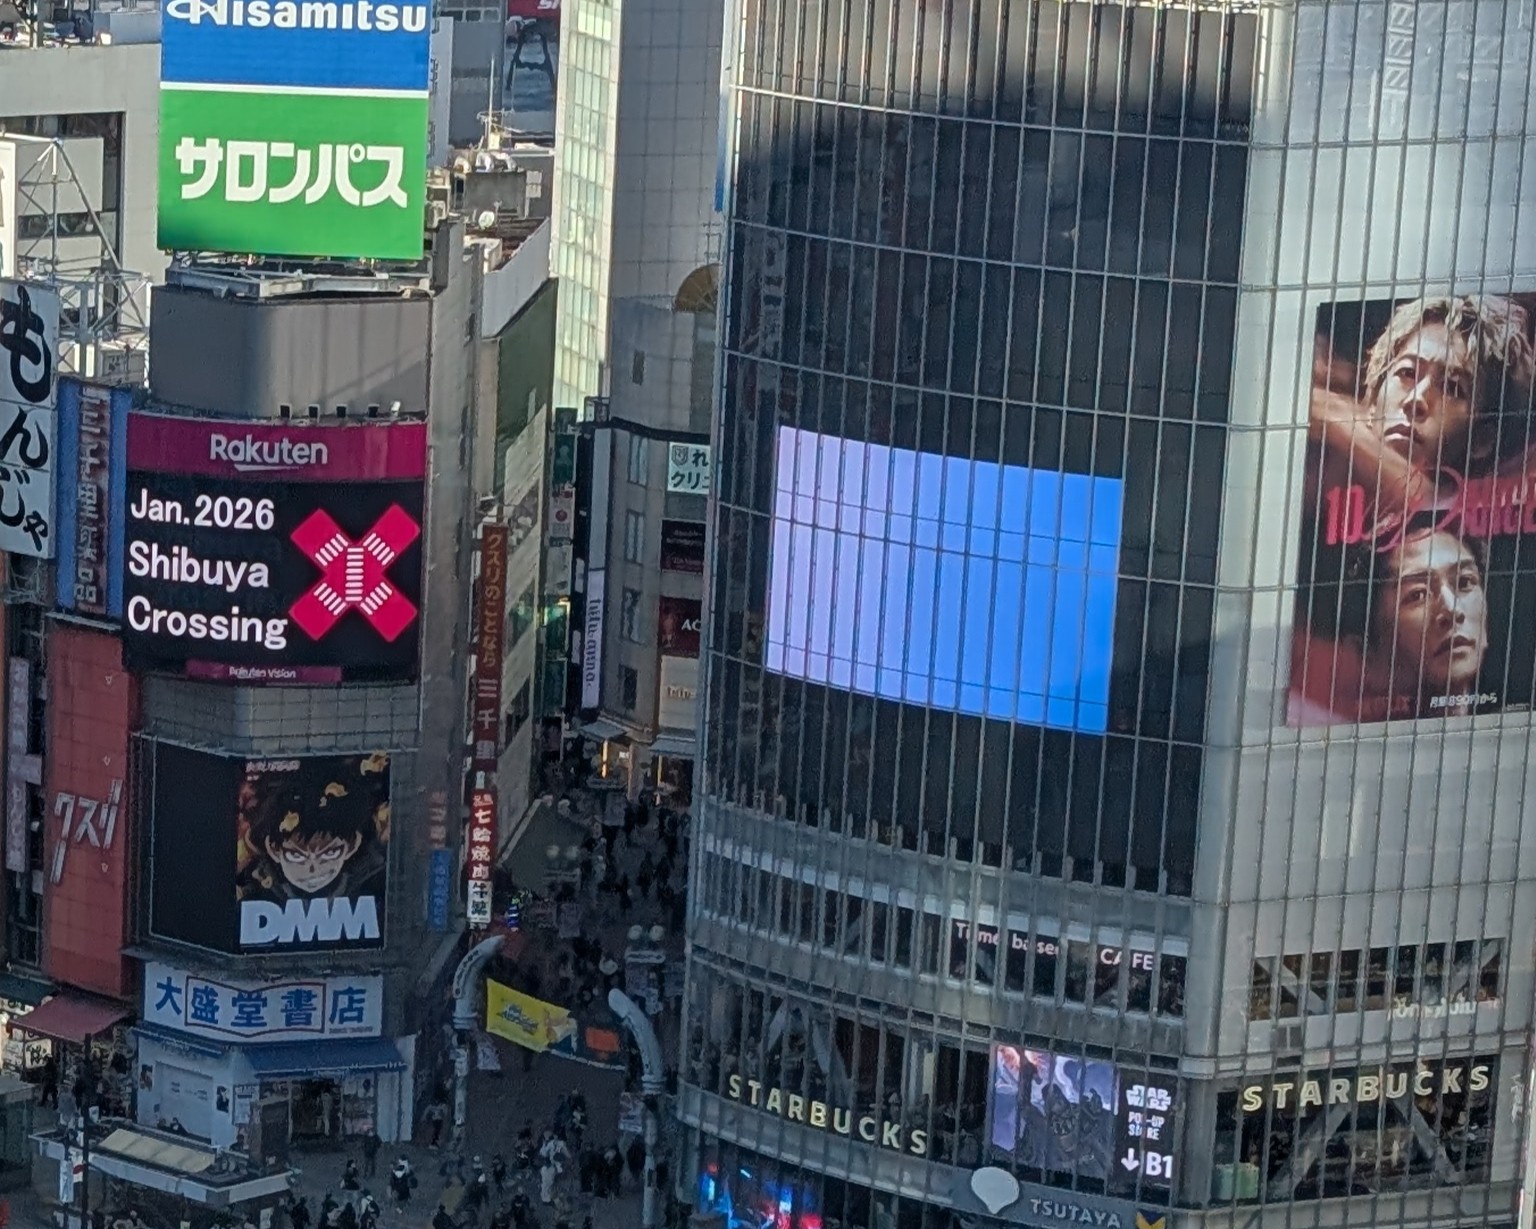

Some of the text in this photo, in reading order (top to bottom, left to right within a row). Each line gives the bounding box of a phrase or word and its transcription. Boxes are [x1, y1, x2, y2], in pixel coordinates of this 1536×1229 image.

[175, 136, 408, 208] サロンパス
[209, 432, 329, 465] Rakuten
[128, 540, 271, 593] Shibuya
[127, 595, 288, 651] Crossing
[49, 778, 124, 884] クスリ
[239, 895, 381, 944] DMM
[155, 976, 367, 1028] 大盛堂書店
[728, 1073, 928, 1155] STARBUCKS
[1242, 1064, 1490, 1113] STARBUCKS
[1145, 1150, 1173, 1179] B1
[1030, 1198, 1121, 1229] TSUTAYA
